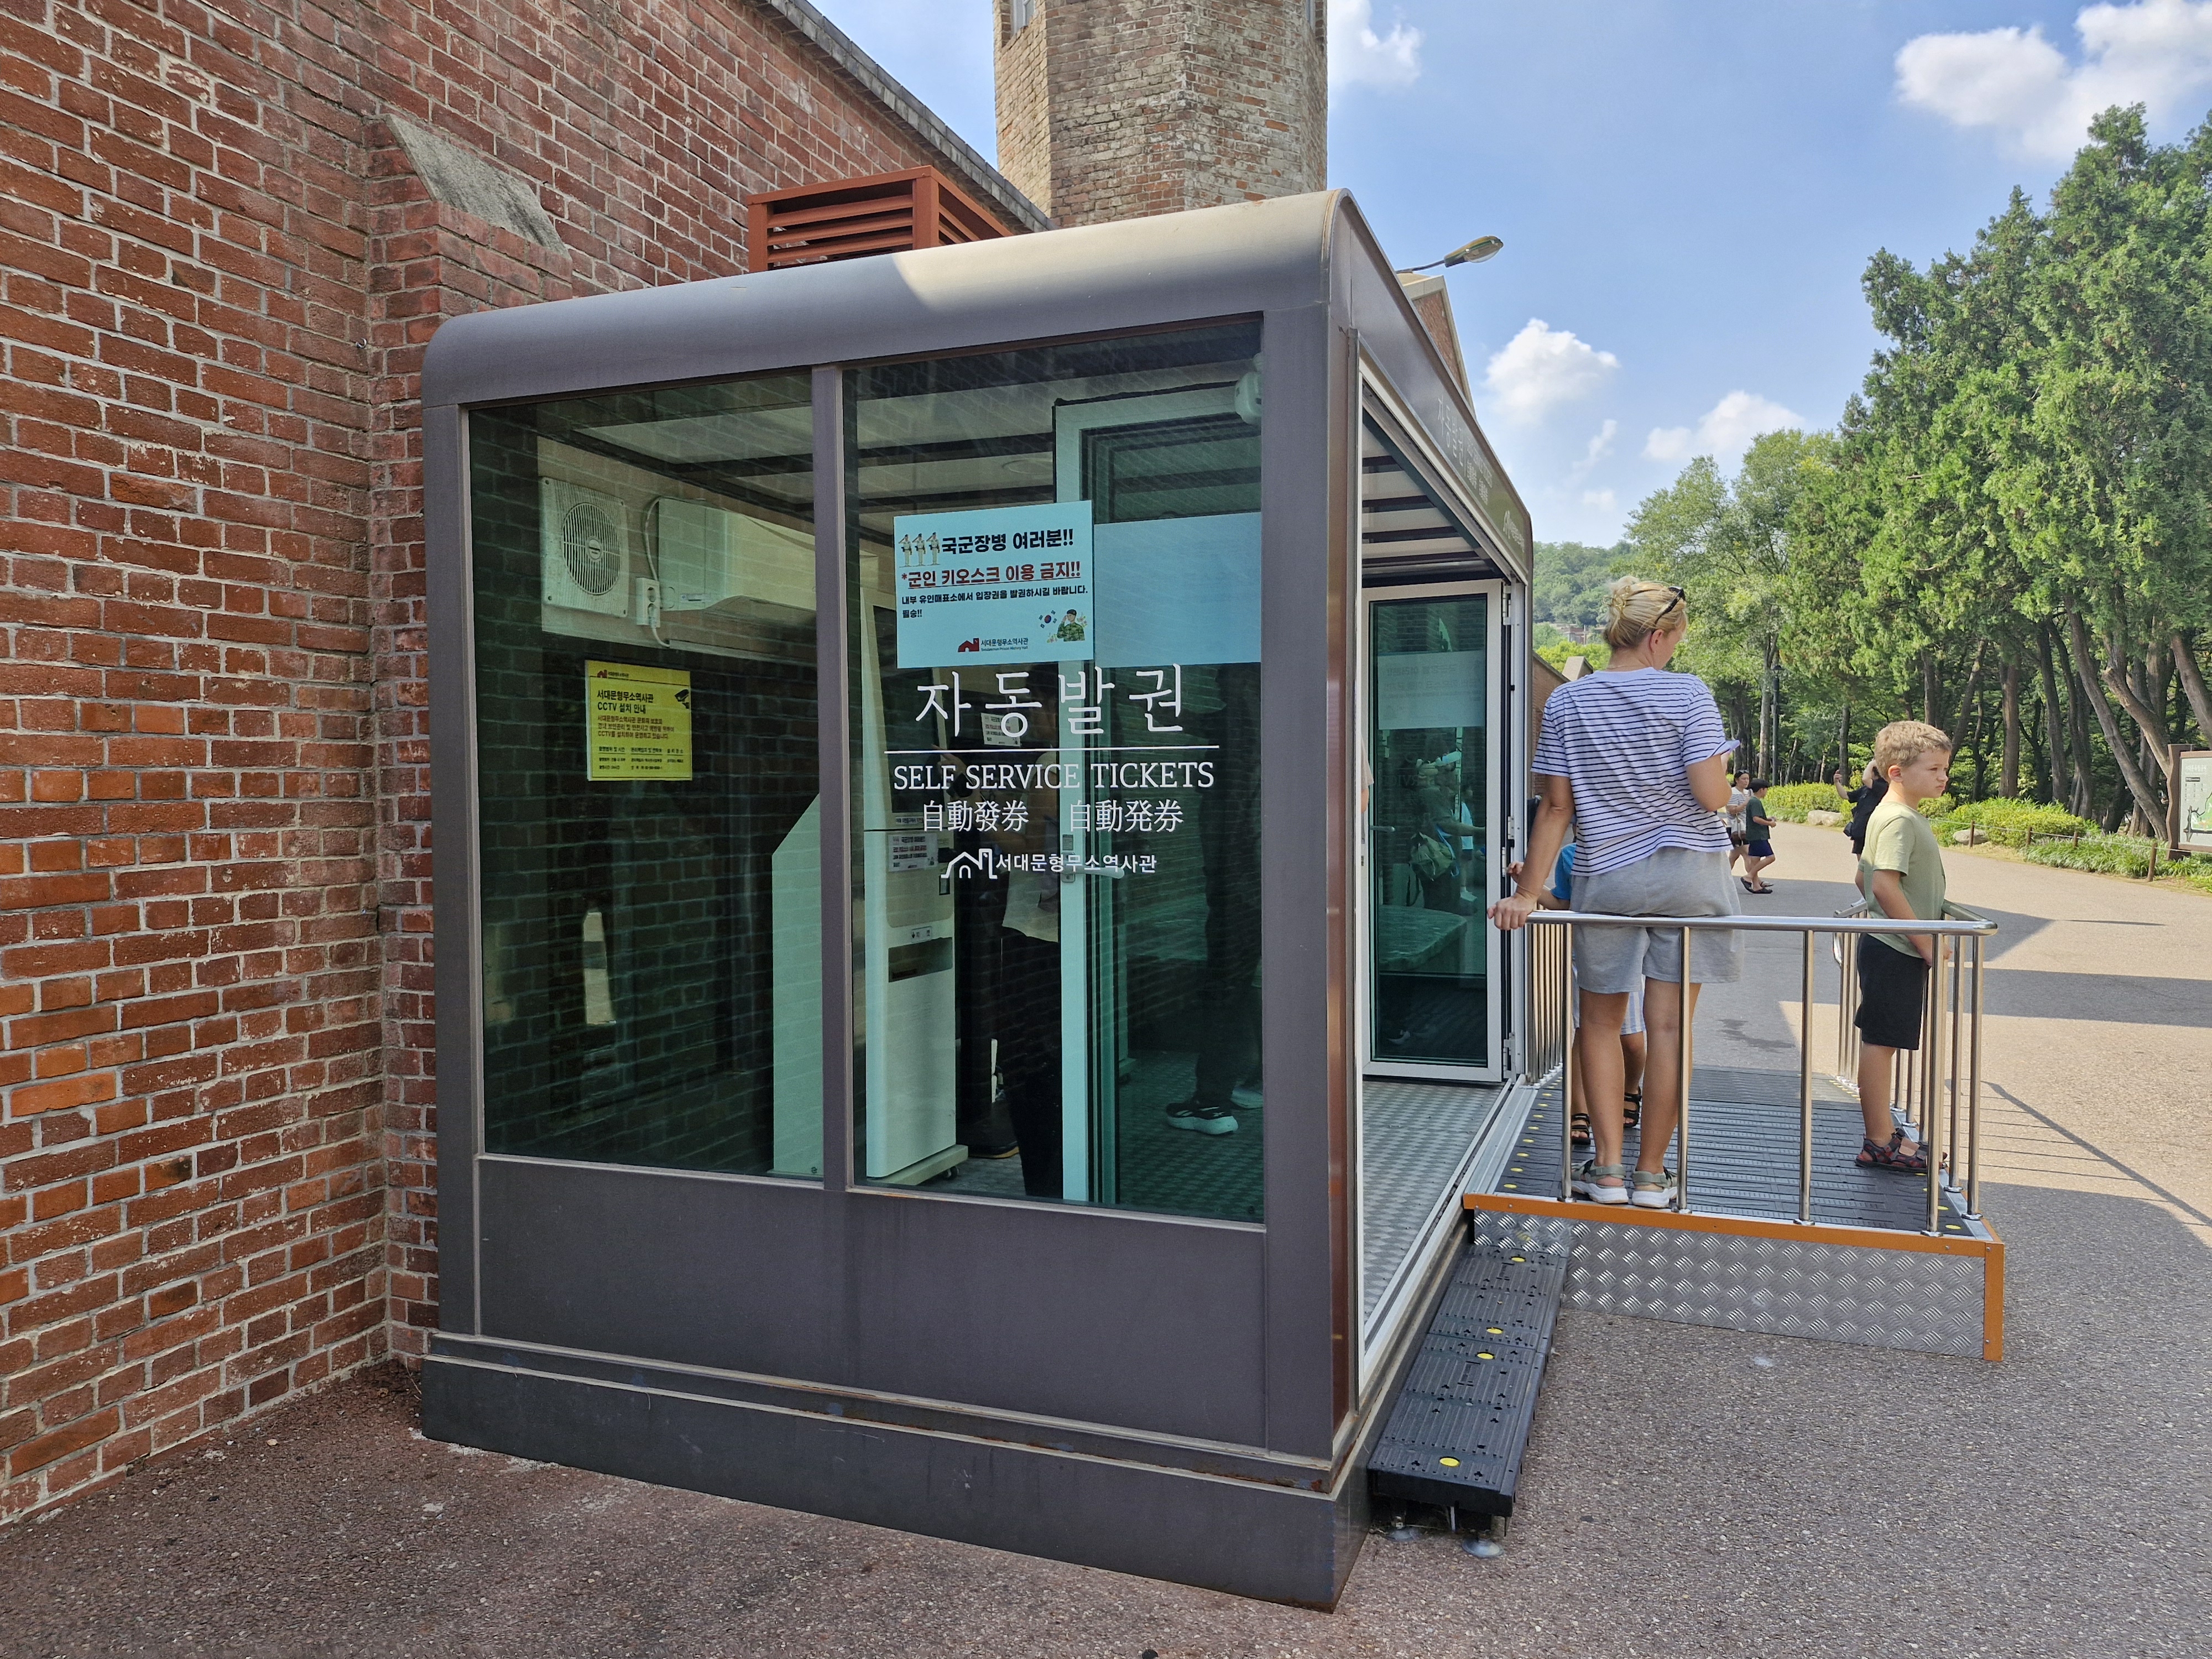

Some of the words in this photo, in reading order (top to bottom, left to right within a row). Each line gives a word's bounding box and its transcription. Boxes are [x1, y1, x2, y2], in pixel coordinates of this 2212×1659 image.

[942, 534, 1006, 554] 국군장병
[1013, 529, 1073, 550] 여러분!!
[942, 566, 1000, 585] 키오스크
[1005, 563, 1035, 581] 이용
[1040, 561, 1081, 579] 금지!!
[902, 596, 917, 604] 내부
[920, 593, 973, 603] 유인매표소에서
[976, 590, 1008, 601] 입장권을
[1010, 587, 1050, 598] 발권하시길
[1053, 585, 1088, 596] 바랍니다.
[902, 609, 922, 618] 필승!!
[981, 638, 1028, 646] 서대문형무소역사관
[597, 690, 654, 703] 서대문형무소역사관
[916, 663, 1183, 737] 자동발권
[597, 702, 617, 711] CCTV
[619, 703, 632, 713] 설치
[634, 704, 646, 714] 안내
[598, 715, 636, 723] 서대문형무소역사관
[894, 765, 957, 790] SELF
[966, 764, 1080, 790] SERVICE
[1091, 762, 1214, 788] TICKETS
[924, 800, 1029, 832] 自動發券
[1070, 799, 1184, 832] 自動発券
[996, 853, 1157, 873] 서대문형무소역사관
